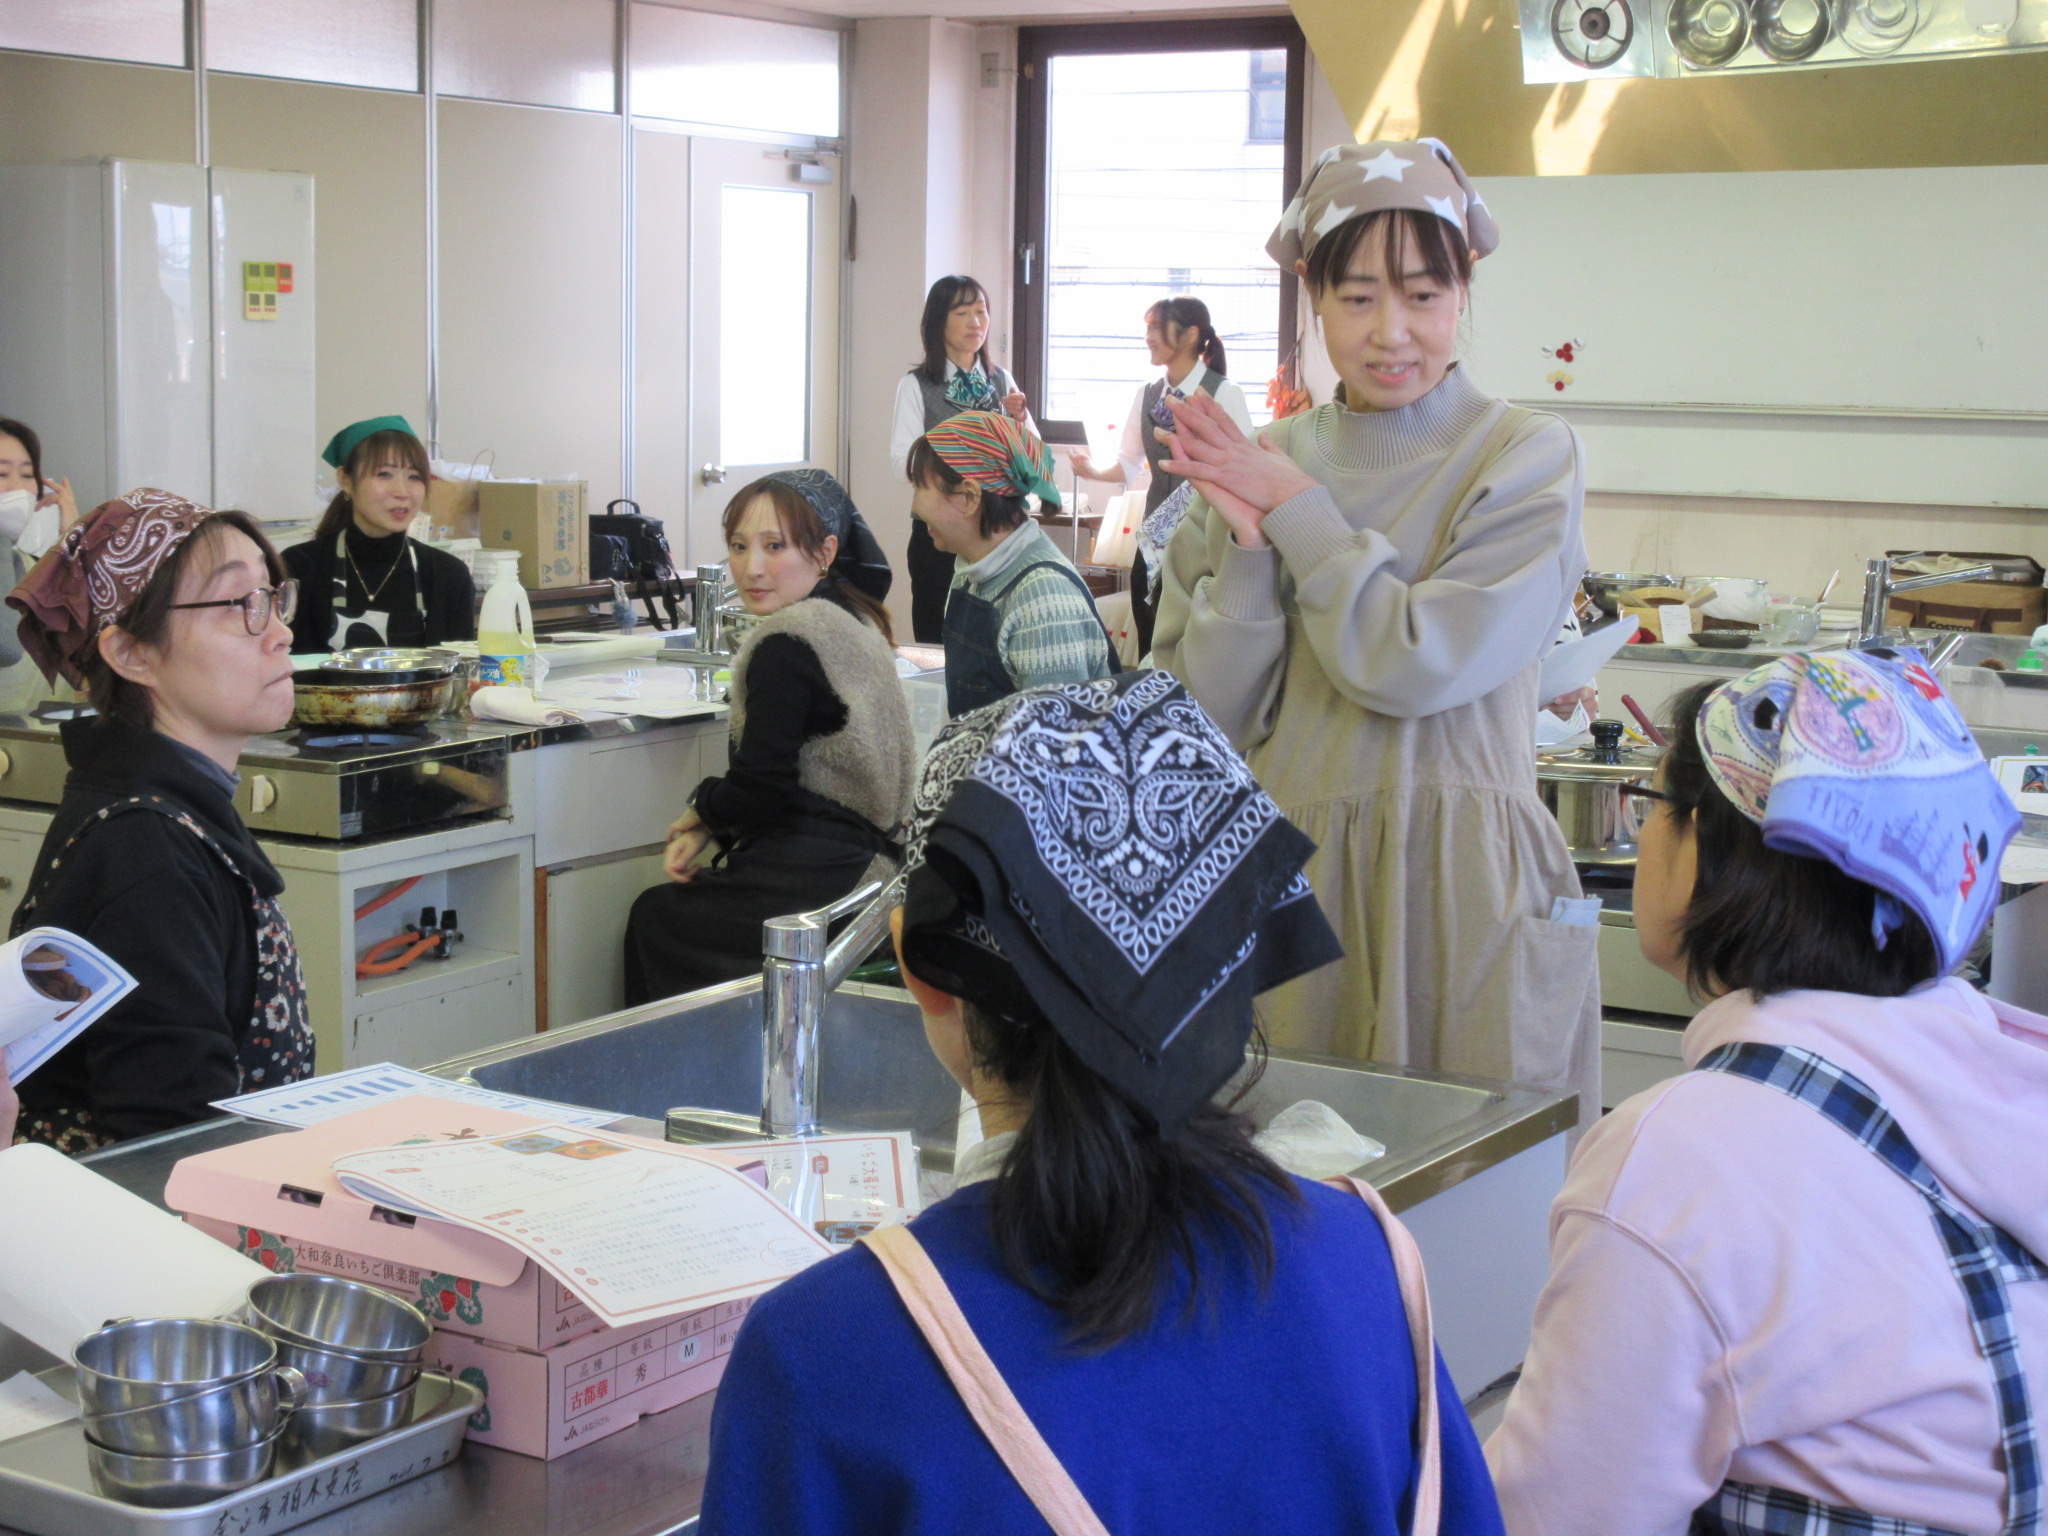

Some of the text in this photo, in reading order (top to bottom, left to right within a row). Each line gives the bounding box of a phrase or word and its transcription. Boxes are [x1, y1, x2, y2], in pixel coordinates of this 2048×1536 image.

[542, 564, 552, 584] A4
[294, 1244, 421, 1287] 大和奈良いちご倶楽部
[683, 1342, 694, 1358] M
[634, 1362, 648, 1385] 秀
[570, 1378, 610, 1412] 古都華
